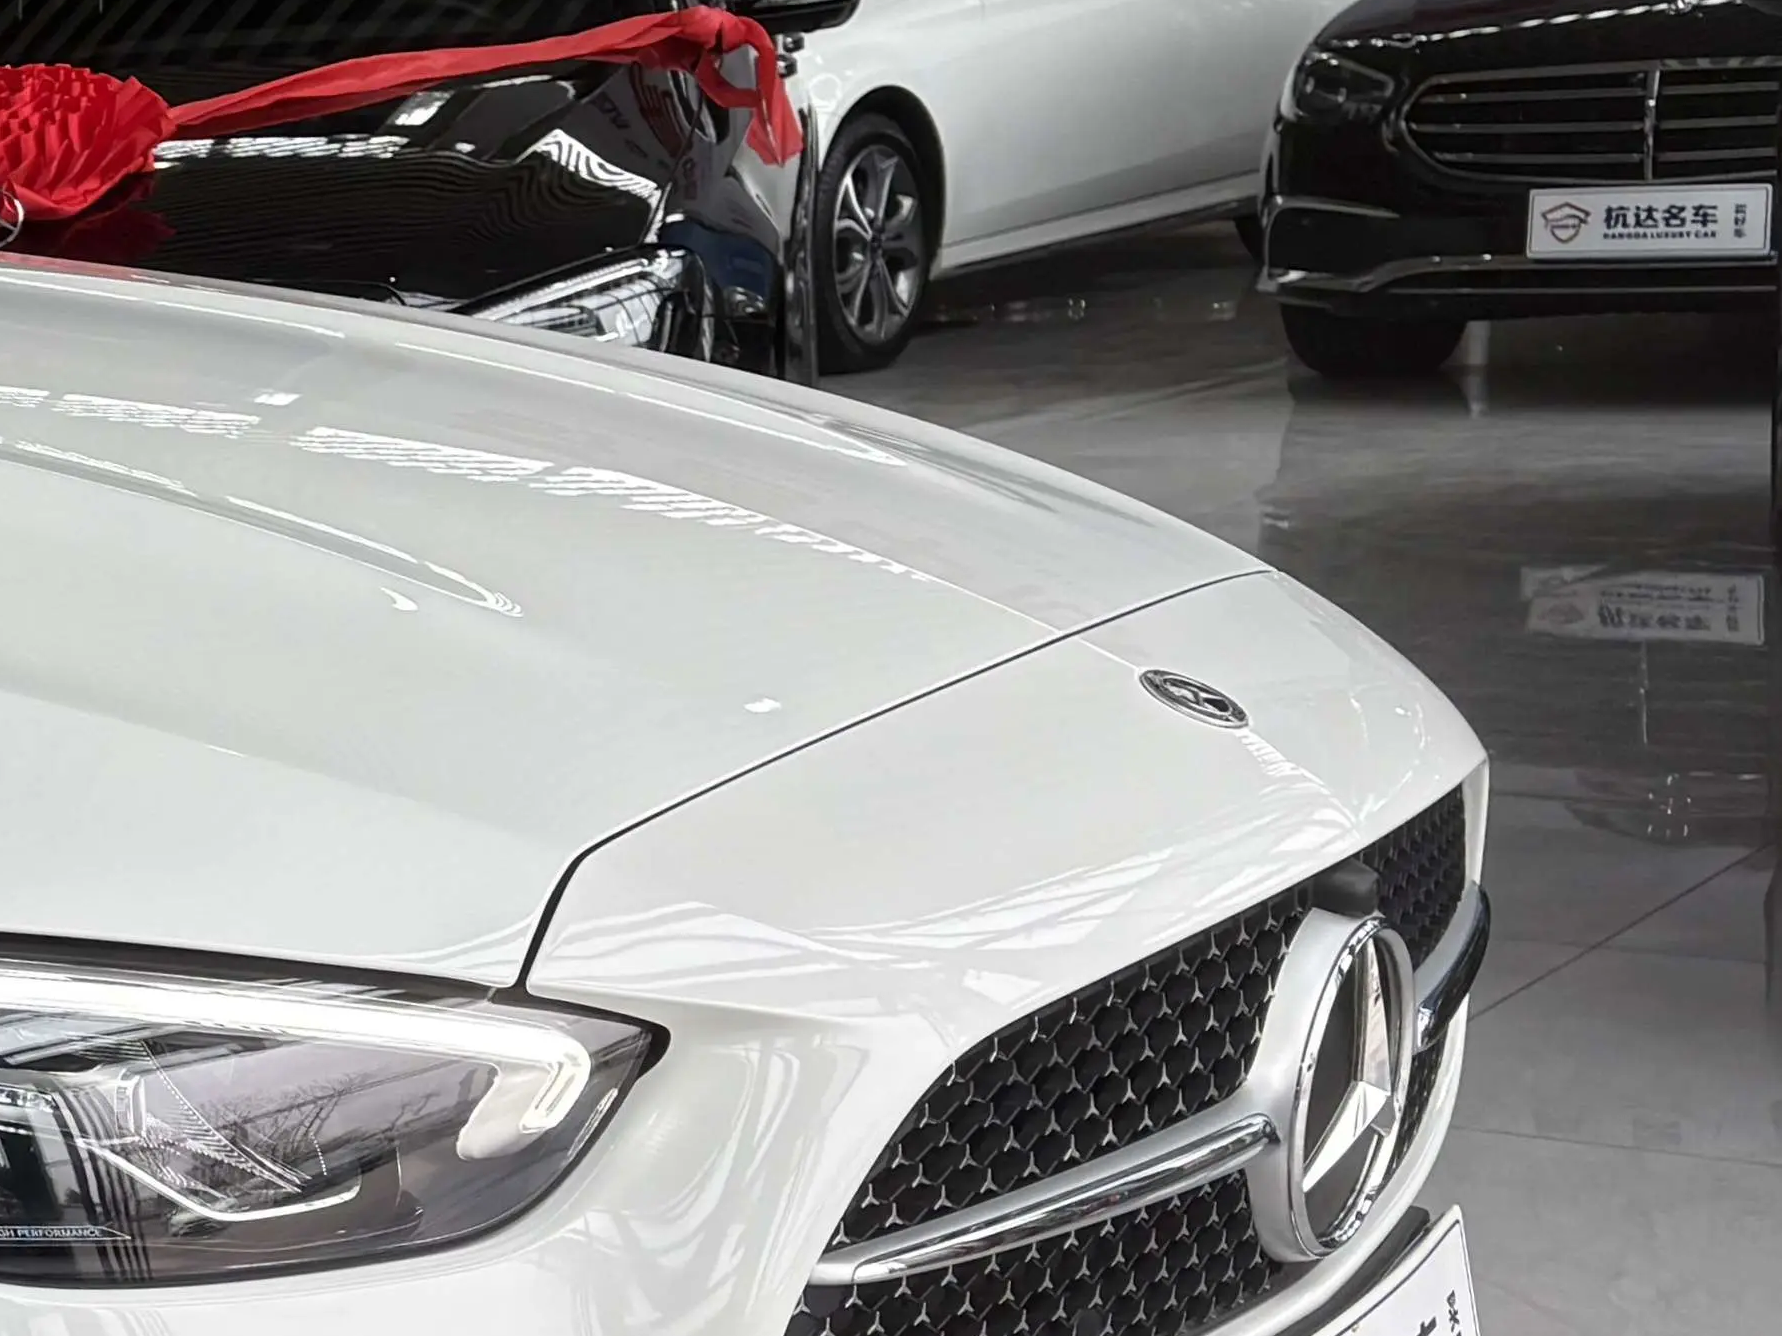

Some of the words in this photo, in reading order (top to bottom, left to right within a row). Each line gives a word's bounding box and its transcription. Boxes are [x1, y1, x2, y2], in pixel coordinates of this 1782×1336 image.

[1604, 203, 1718, 230] 杭达名车
[18, 1227, 103, 1238] PERFORMANCE
